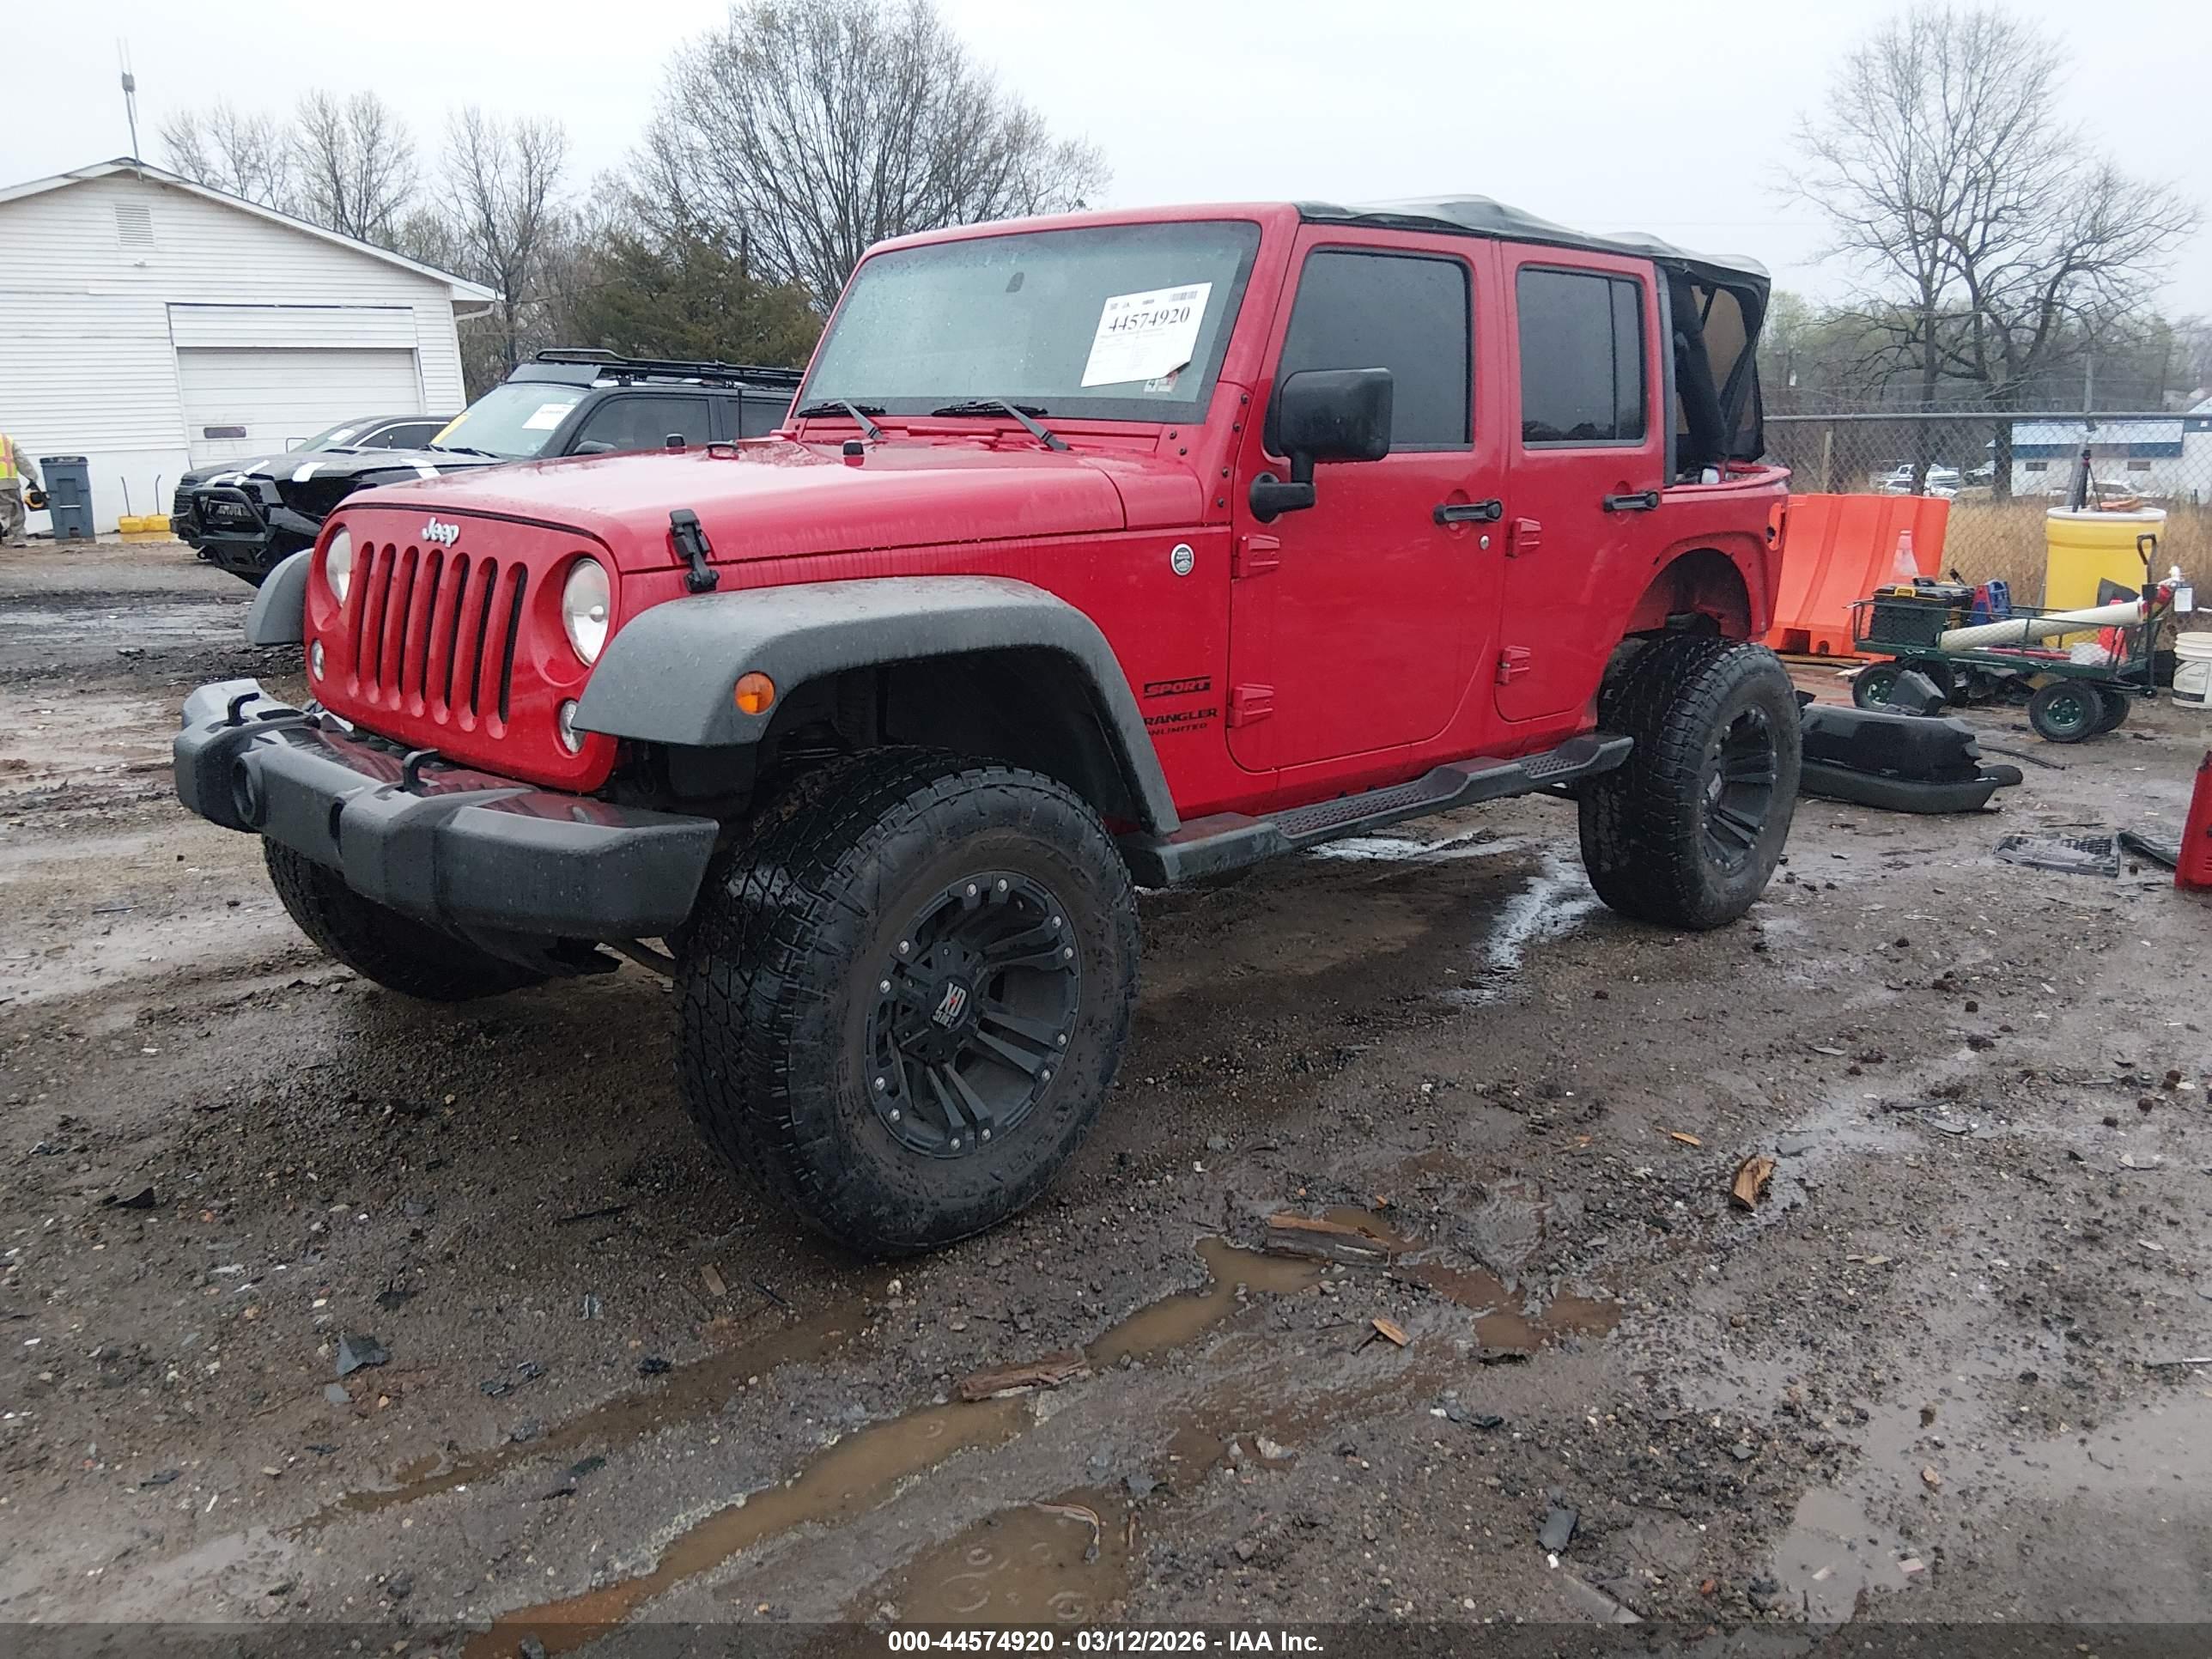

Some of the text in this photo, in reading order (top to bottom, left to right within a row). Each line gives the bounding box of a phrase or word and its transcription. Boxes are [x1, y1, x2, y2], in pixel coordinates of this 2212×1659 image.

[1108, 307, 1191, 332] 44574920
[422, 517, 459, 548] Jeep
[1144, 676, 1211, 700] SPORT
[1144, 708, 1218, 726] RANGLER
